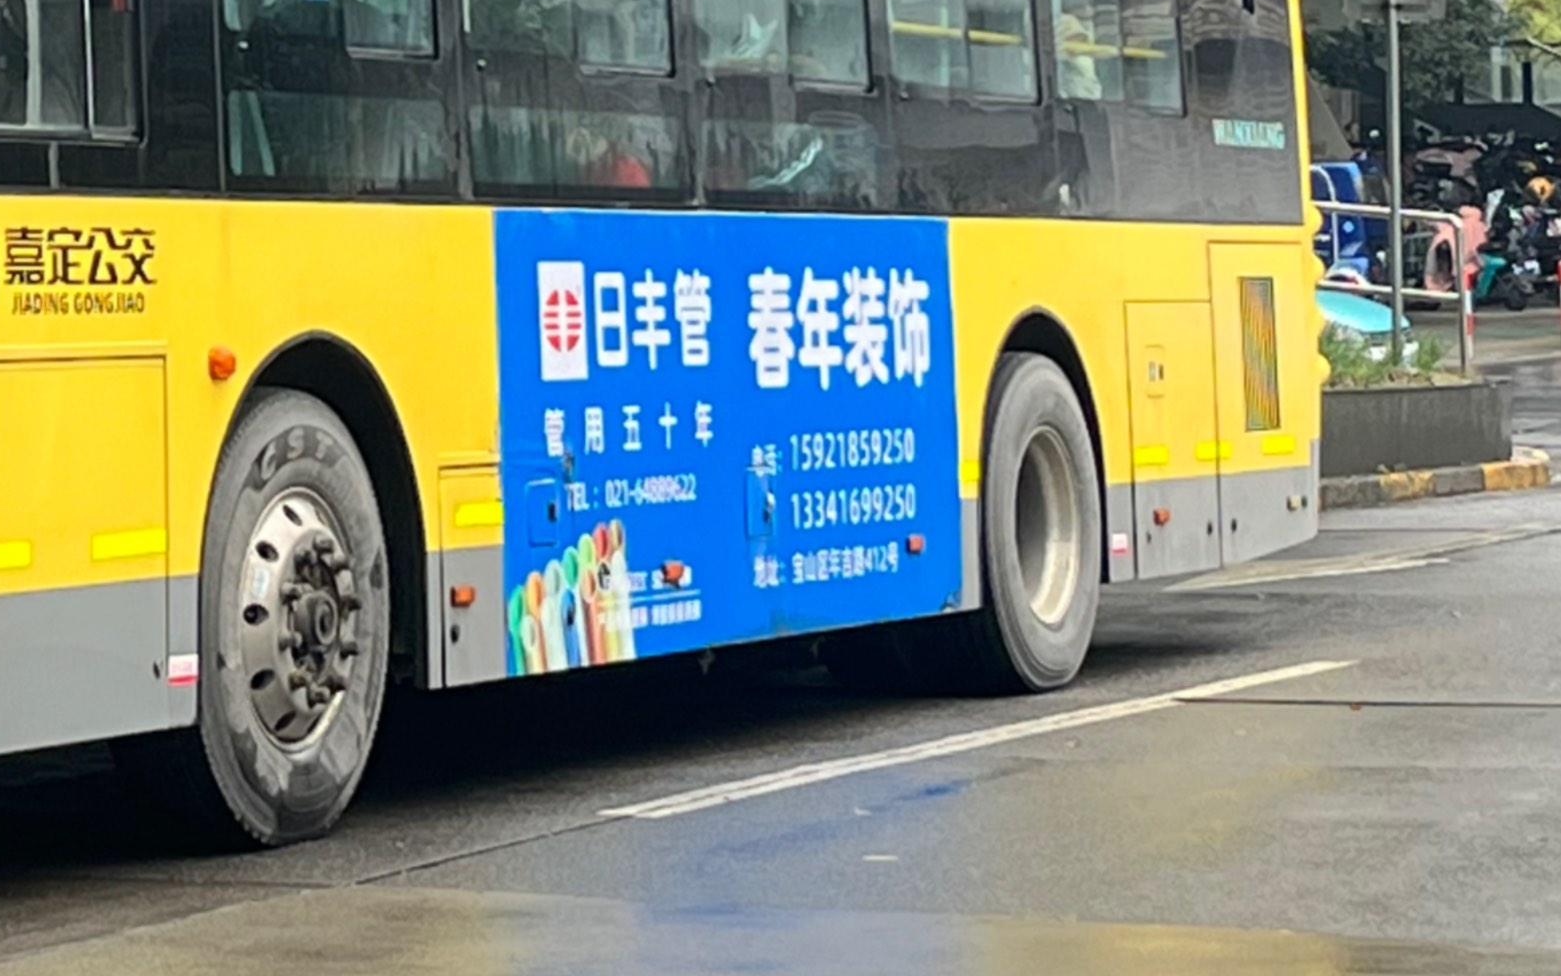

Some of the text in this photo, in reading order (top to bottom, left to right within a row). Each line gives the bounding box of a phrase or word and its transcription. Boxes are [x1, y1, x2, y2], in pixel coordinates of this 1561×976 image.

[3, 226, 158, 285] 嘉定公交
[11, 291, 69, 315] JIADING
[594, 265, 931, 391] 日丰管 春年装饰
[790, 427, 916, 471] 15921859250
[791, 483, 916, 529] 13341699250
